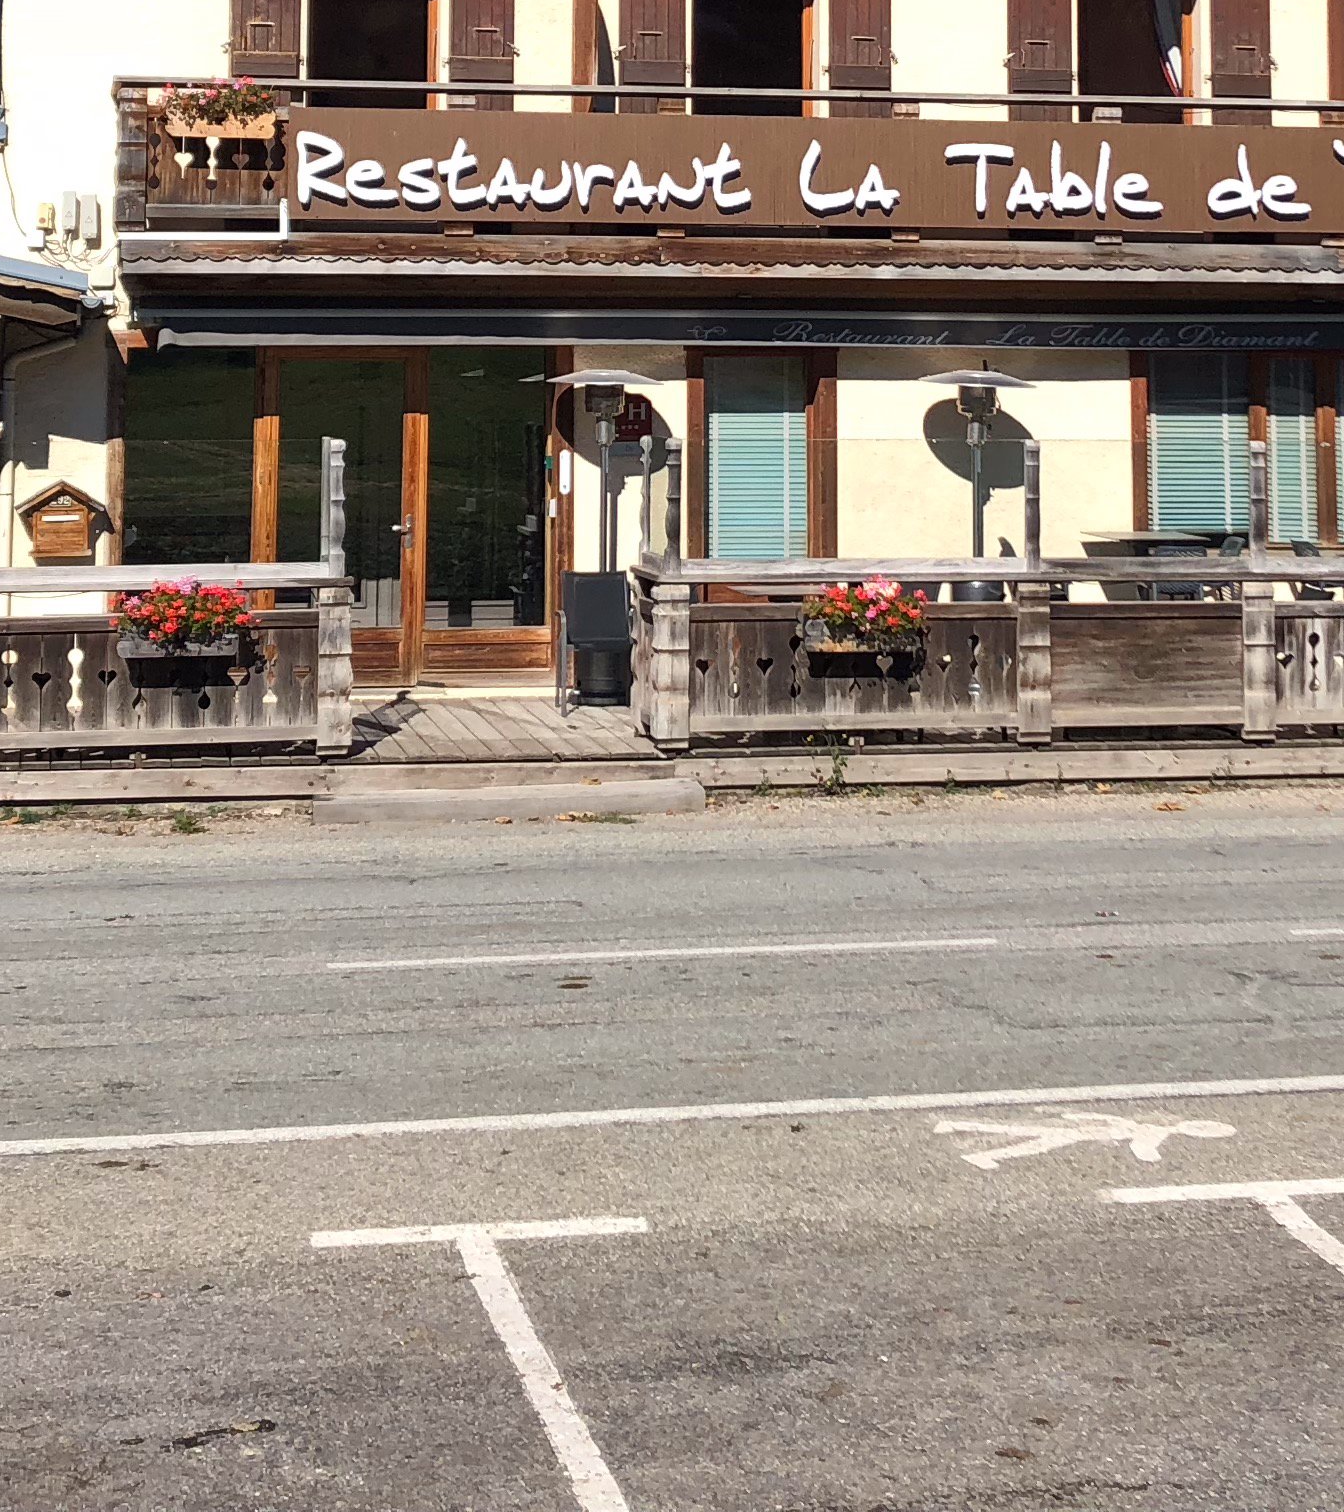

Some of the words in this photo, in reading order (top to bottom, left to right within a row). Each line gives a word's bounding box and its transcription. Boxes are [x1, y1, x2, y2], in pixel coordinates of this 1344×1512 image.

[296, 130, 752, 212] Restaurant
[944, 140, 1164, 216] Table
[1206, 144, 1313, 218] de
[771, 320, 951, 346] Restaurant
[985, 323, 1036, 346] La
[1049, 323, 1131, 347] Table
[1138, 327, 1171, 347] de
[1177, 324, 1320, 348] Diamant
[628, 402, 646, 421] H
